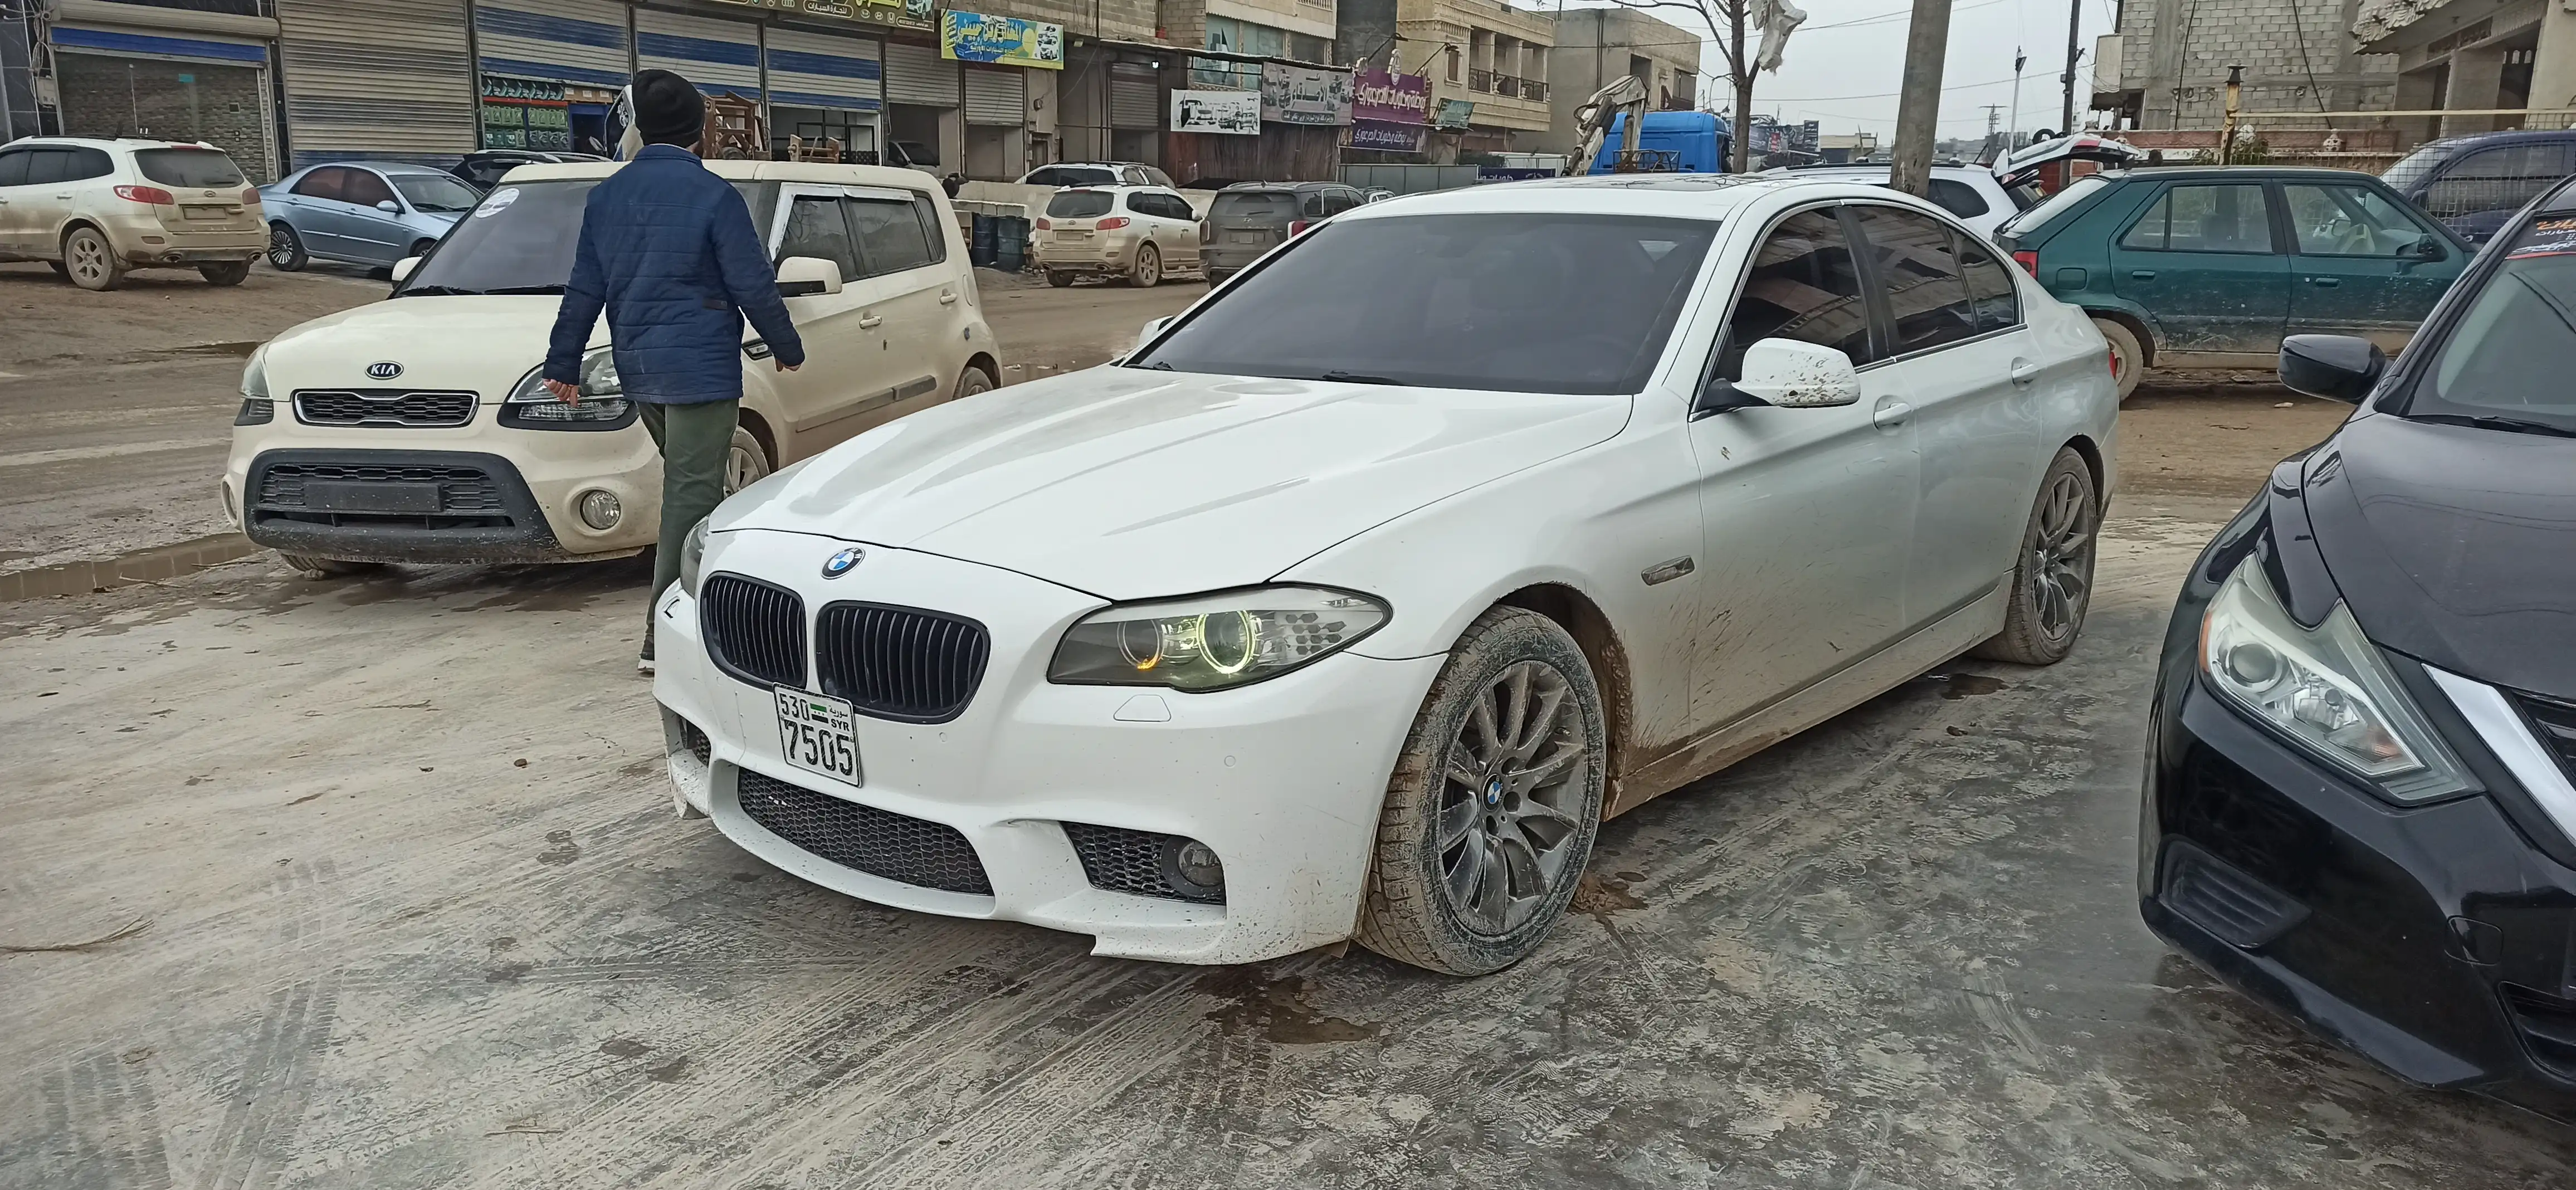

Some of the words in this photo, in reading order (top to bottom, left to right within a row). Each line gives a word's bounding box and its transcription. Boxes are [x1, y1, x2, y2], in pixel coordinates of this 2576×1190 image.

[808, 2, 830, 12] السيارات
[830, 5, 847, 14] لتجارة
[371, 364, 395, 374] KIA
[779, 692, 809, 720] 530
[829, 705, 848, 718] سورية
[831, 719, 850, 731] SYR
[784, 719, 853, 776] 7505
